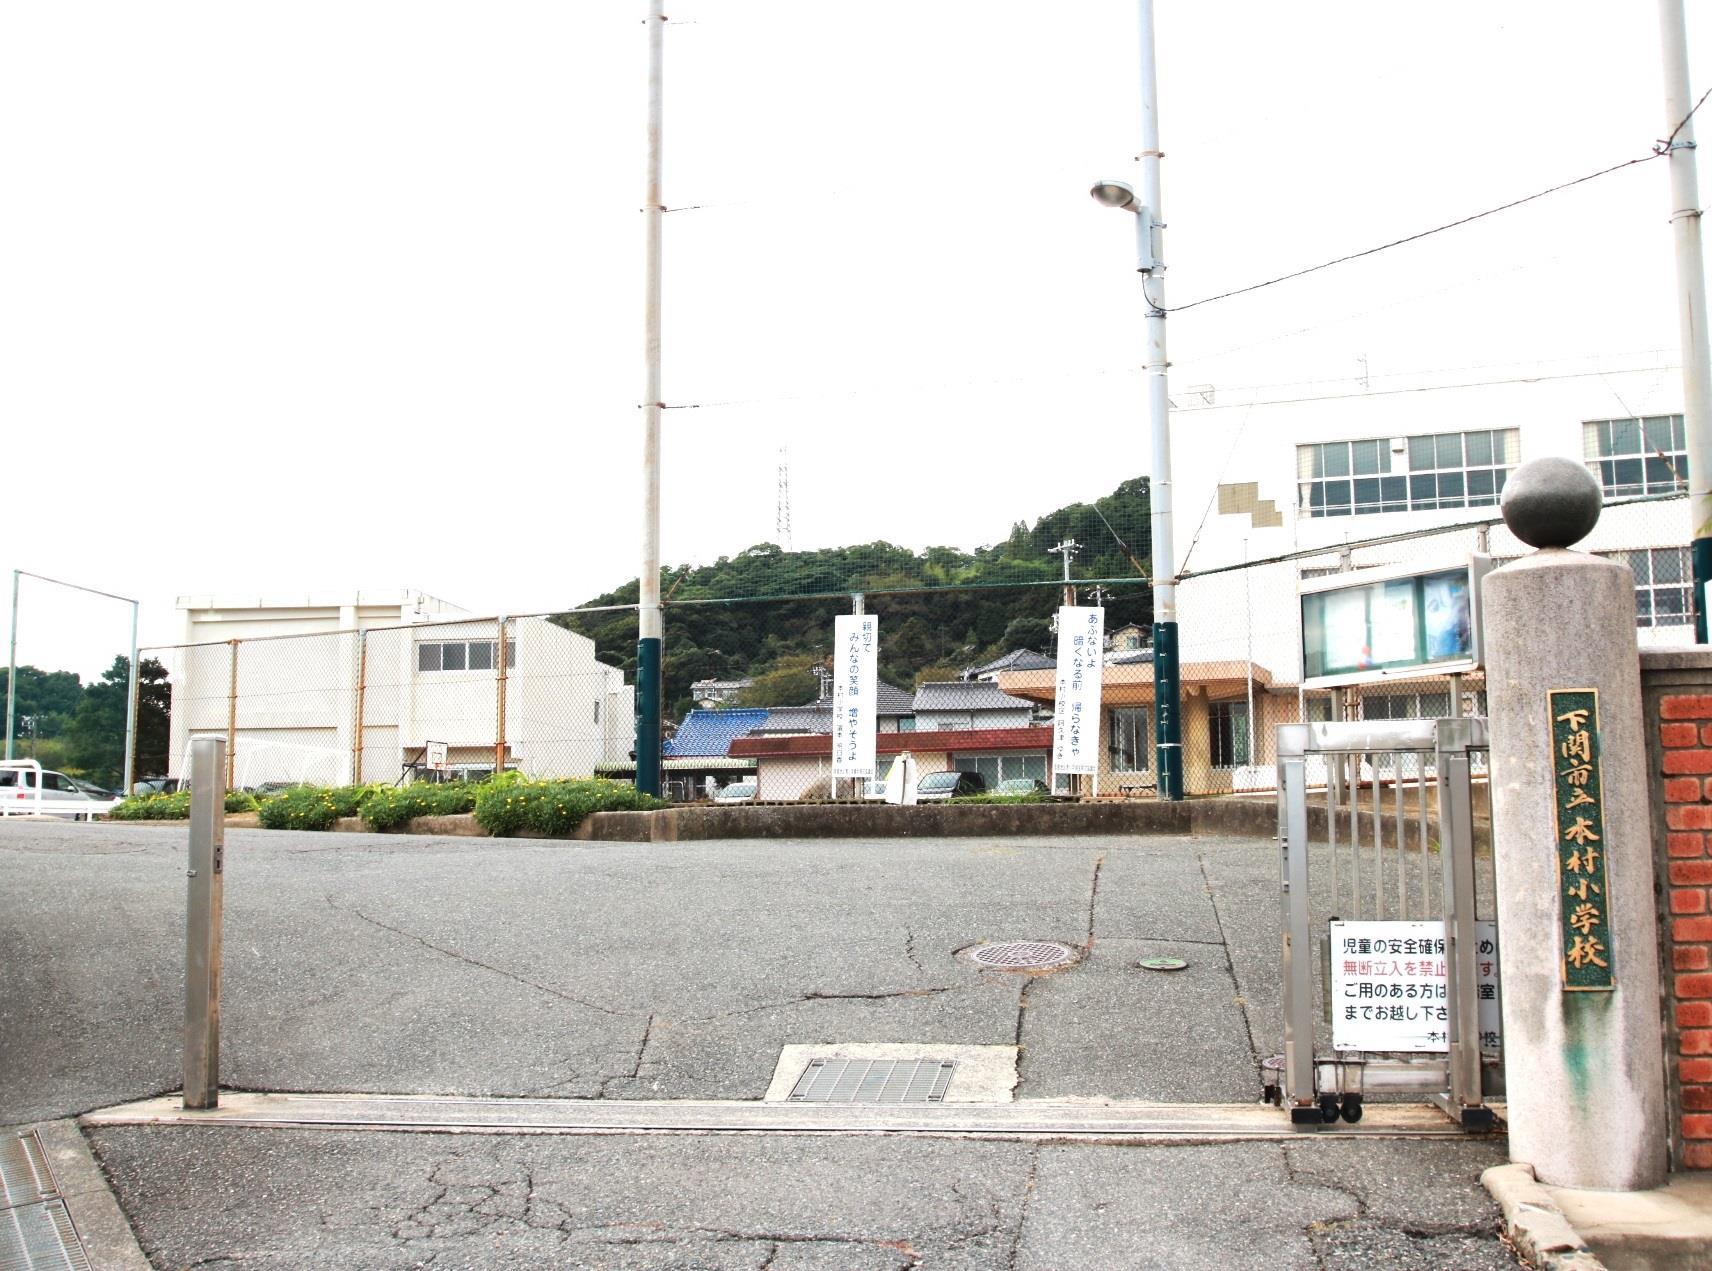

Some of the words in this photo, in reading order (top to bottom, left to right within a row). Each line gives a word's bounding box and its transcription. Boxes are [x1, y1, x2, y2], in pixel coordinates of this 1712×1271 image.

[848, 632, 860, 696] みんなの笑顔
[1072, 635, 1085, 691] 暗くなる前
[848, 707, 859, 761] 増やそうよ
[1070, 701, 1082, 757] 帰らなきゃ
[1557, 709, 1607, 968] 下関市立本村小学校
[1343, 938, 1494, 955] 児童の安全確保め
[1344, 982, 1496, 1000] ご用のある方は室
[1345, 1005, 1448, 1021] までお越し下さ
